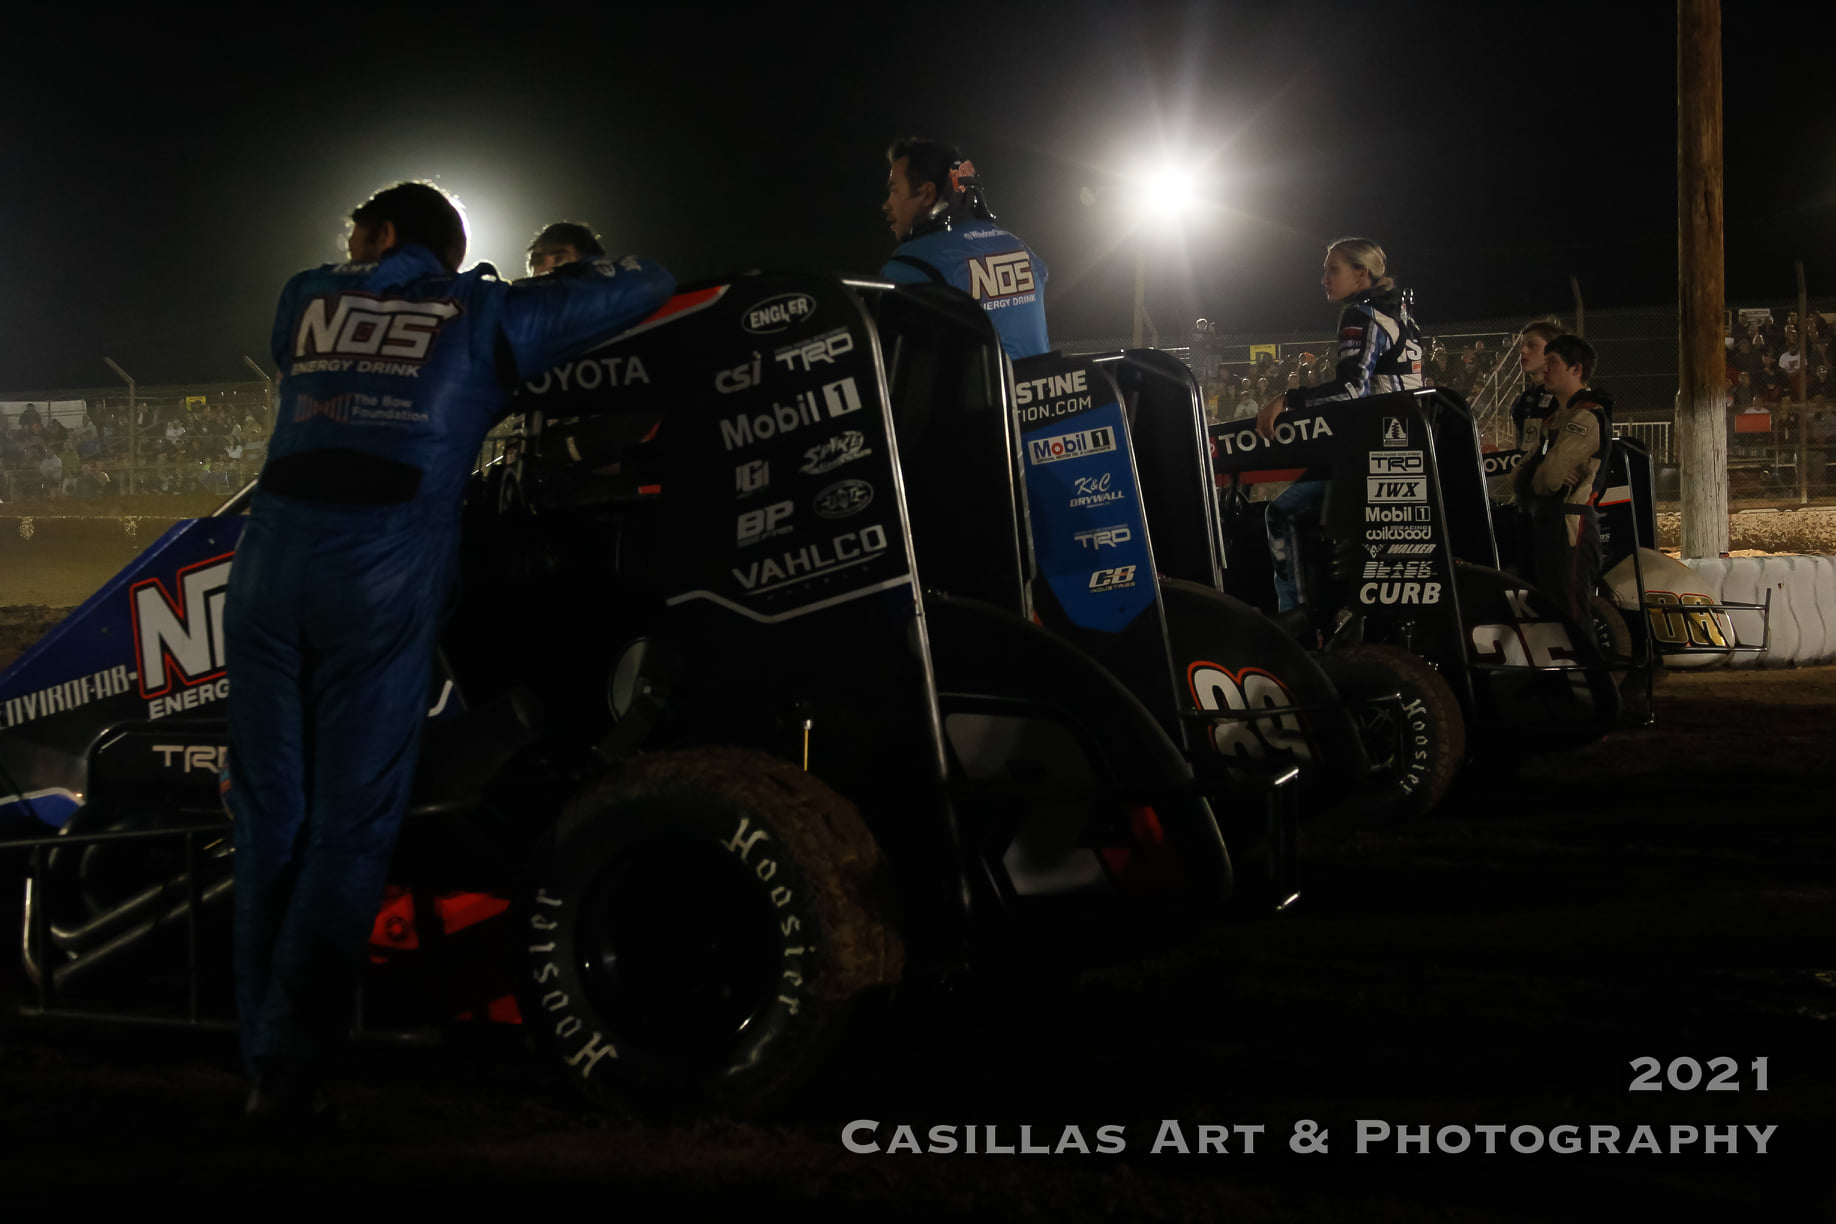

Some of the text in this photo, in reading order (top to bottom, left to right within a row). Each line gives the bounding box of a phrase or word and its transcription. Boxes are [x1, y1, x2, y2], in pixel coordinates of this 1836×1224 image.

[968, 251, 1035, 300] NOS
[750, 297, 809, 329] ENGLER
[294, 294, 463, 359] NOS
[775, 331, 855, 372] TRD
[291, 359, 421, 378] ENERGY DRINK
[354, 393, 377, 407] The
[352, 406, 429, 422] Foundation
[719, 390, 821, 452] Mobil
[1033, 434, 1087, 461] Mobil
[1371, 456, 1422, 471] TRD
[1074, 472, 1111, 495] K&C
[1375, 482, 1419, 498] IWX
[1069, 490, 1125, 508] DRYWALL
[737, 500, 794, 543] BP
[1365, 507, 1411, 522] Mobil
[1074, 528, 1131, 550] TRD
[1365, 526, 1432, 540] wilwood
[731, 524, 888, 589] VAHLCO
[1360, 582, 1442, 605] CURB
[1505, 589, 1540, 618] K
[721, 817, 816, 1016] Hoosier
[528, 888, 619, 1079] Hoosier
